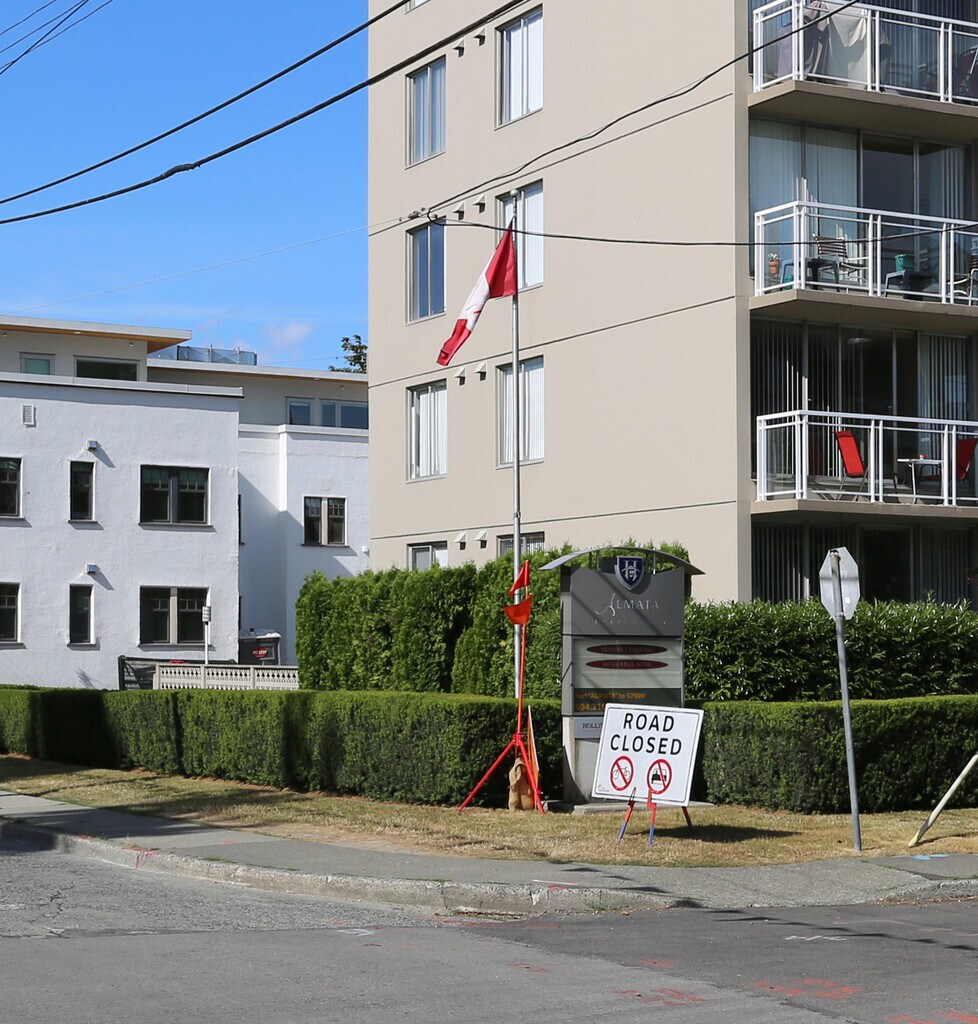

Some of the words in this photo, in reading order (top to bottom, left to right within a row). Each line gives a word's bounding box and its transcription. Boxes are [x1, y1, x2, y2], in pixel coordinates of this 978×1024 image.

[595, 593, 660, 616] ALMATA
[623, 713, 675, 732] ROAD
[610, 734, 682, 755] CLOSED
